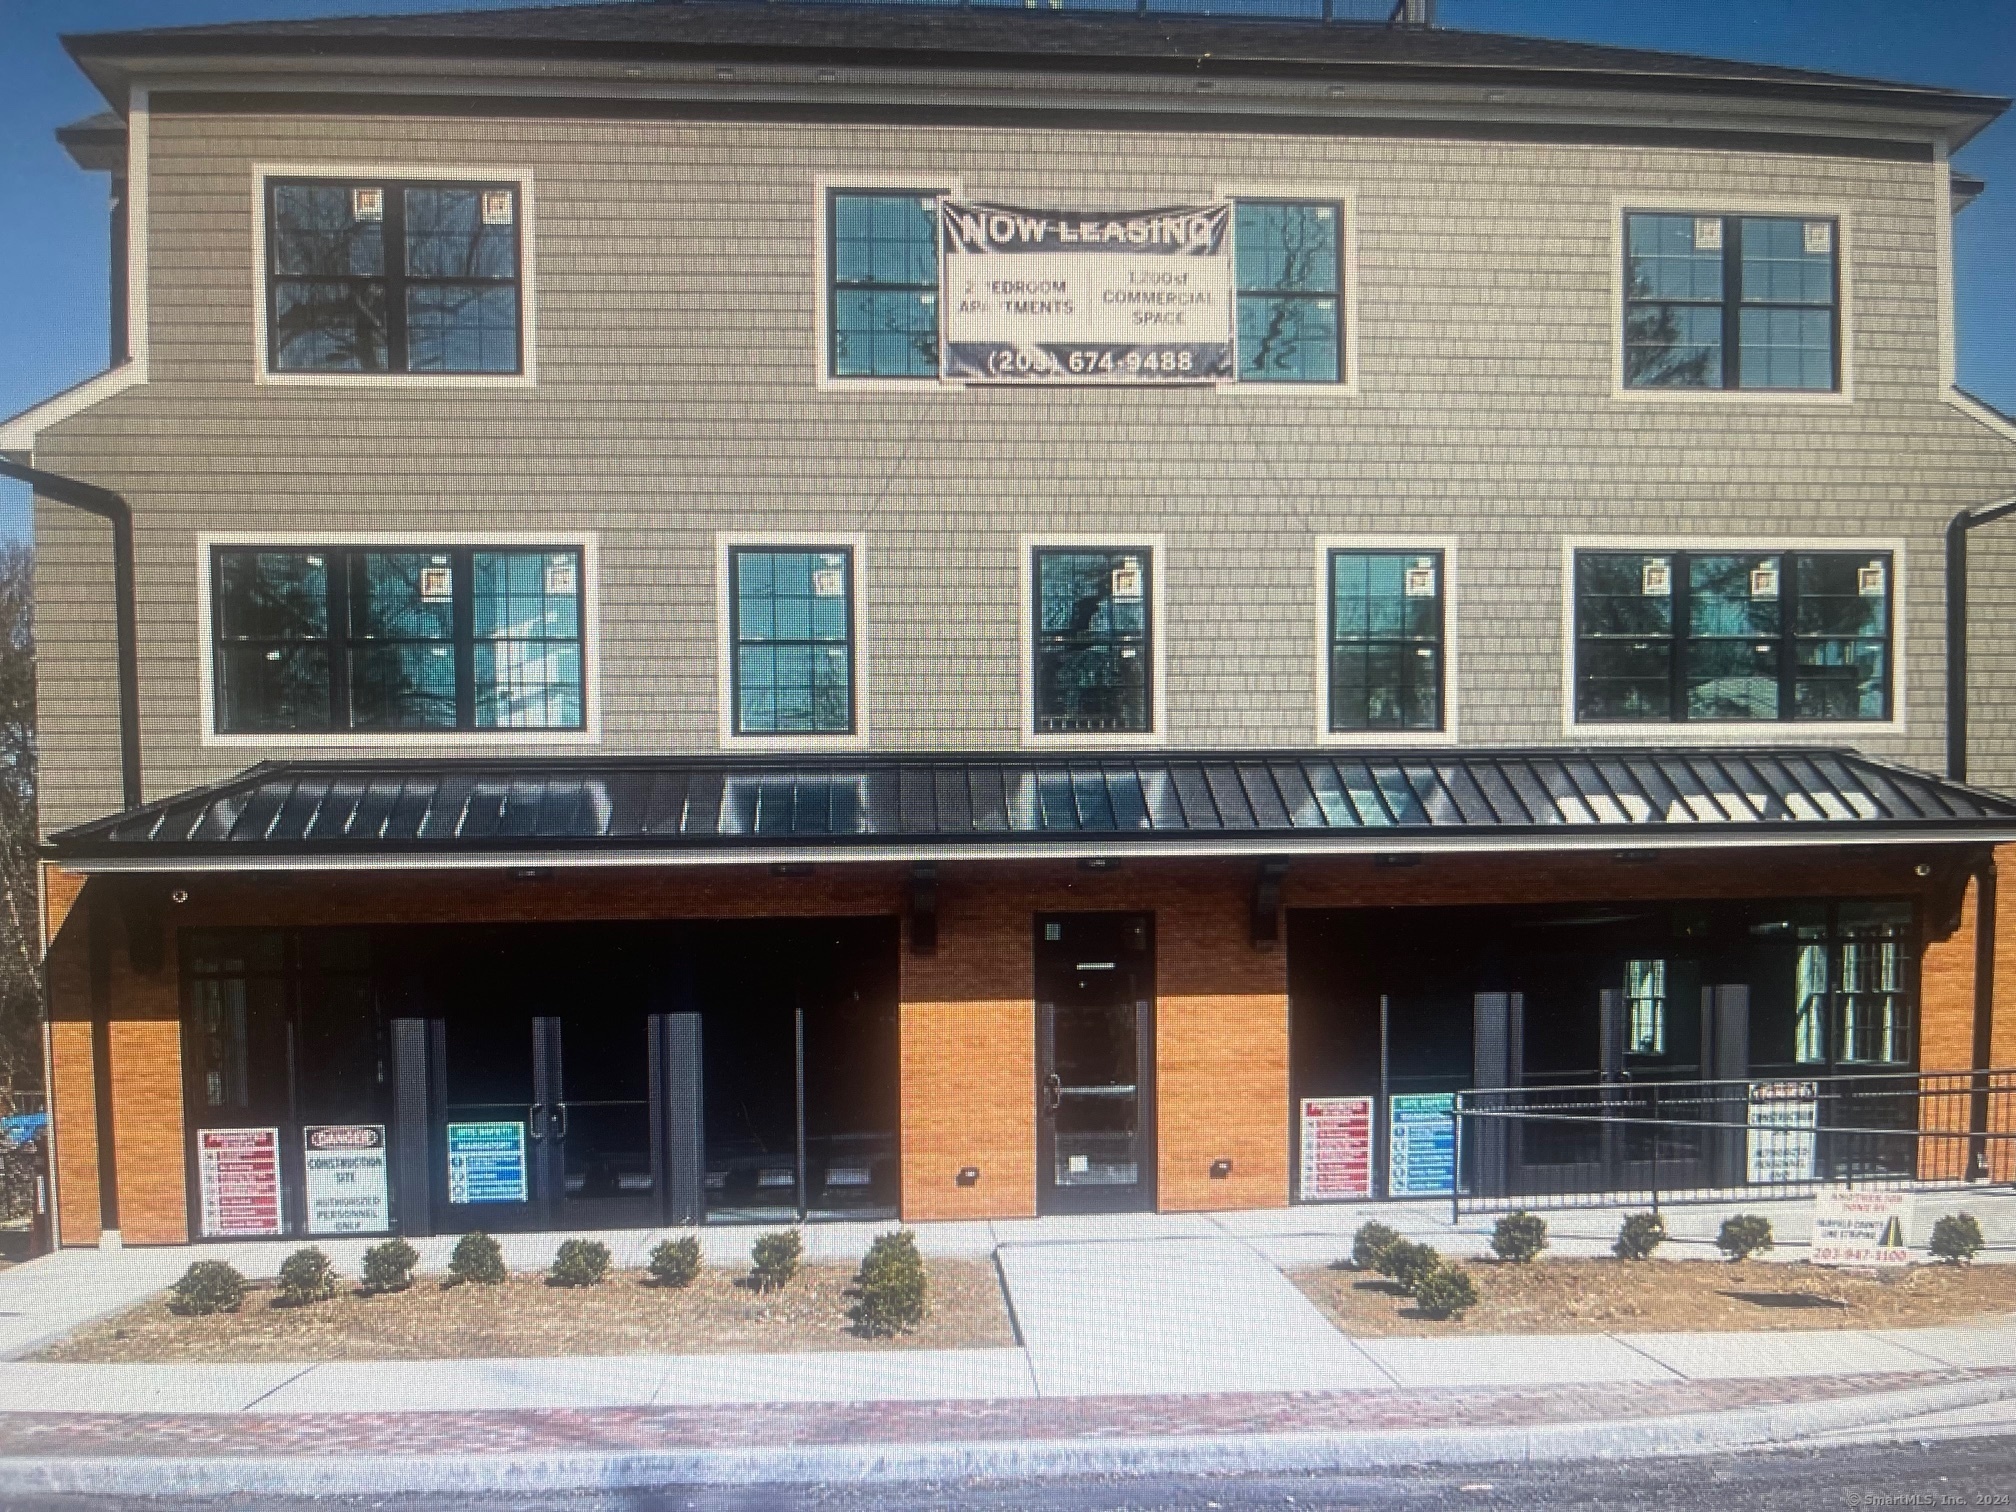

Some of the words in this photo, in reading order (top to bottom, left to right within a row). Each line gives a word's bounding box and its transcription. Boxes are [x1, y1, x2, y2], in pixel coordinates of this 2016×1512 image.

[961, 213, 1047, 244] NOW
[1059, 213, 1213, 245] LEASING
[1102, 291, 1212, 306] COMMERCIAL
[1132, 310, 1185, 325] SPACE
[1069, 350, 1194, 373] 674-9488
[308, 1158, 383, 1170] CONSTRUCTION
[315, 1197, 380, 1208] AUTHORIZED
[1831, 1193, 1882, 1203] ANOTHER
[316, 1209, 378, 1219] PERSONNEL
[334, 1221, 362, 1231] ONLY
[1854, 1220, 1884, 1229] COUNTY
[1813, 1247, 1907, 1262] 203-947-1100
